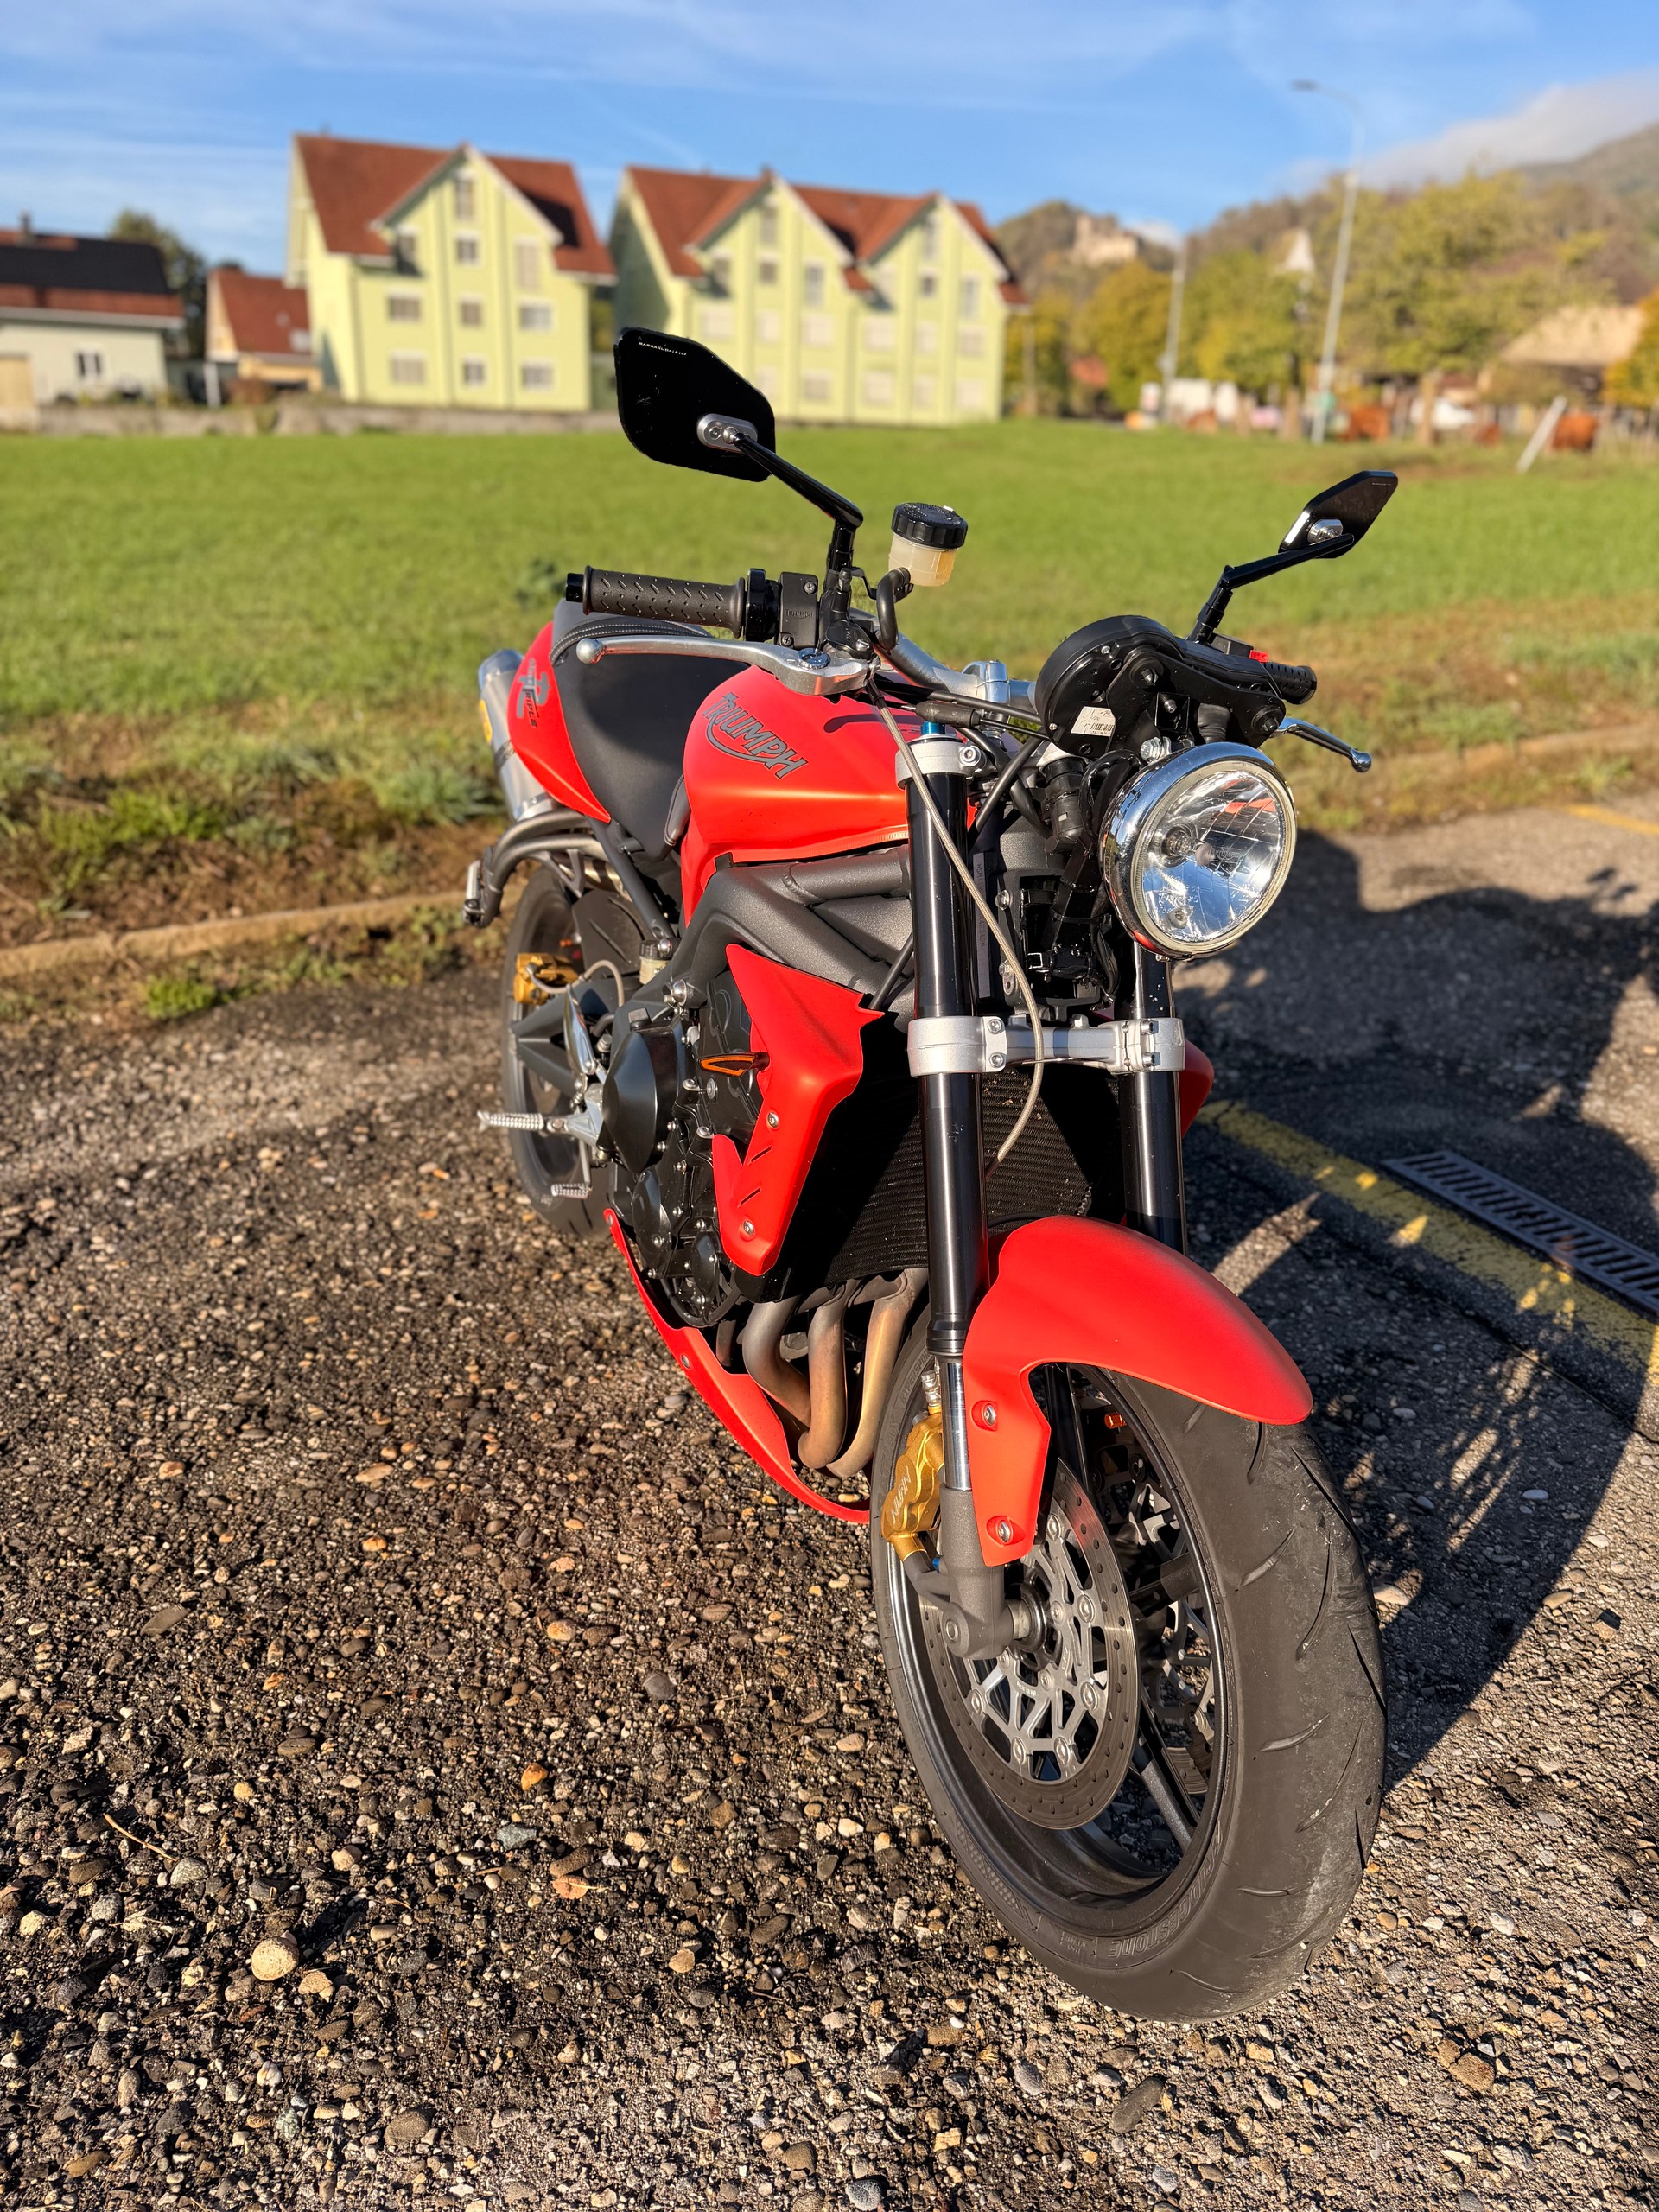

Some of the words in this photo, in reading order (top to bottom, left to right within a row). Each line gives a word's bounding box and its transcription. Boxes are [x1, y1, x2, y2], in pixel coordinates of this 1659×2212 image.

[701, 691, 810, 780] TRIUMPH
[899, 1347, 931, 1405] HYPERSPOR
[890, 1465, 912, 1526] NISSIN
[1108, 1820, 1224, 1959] BRIDGESTONE
